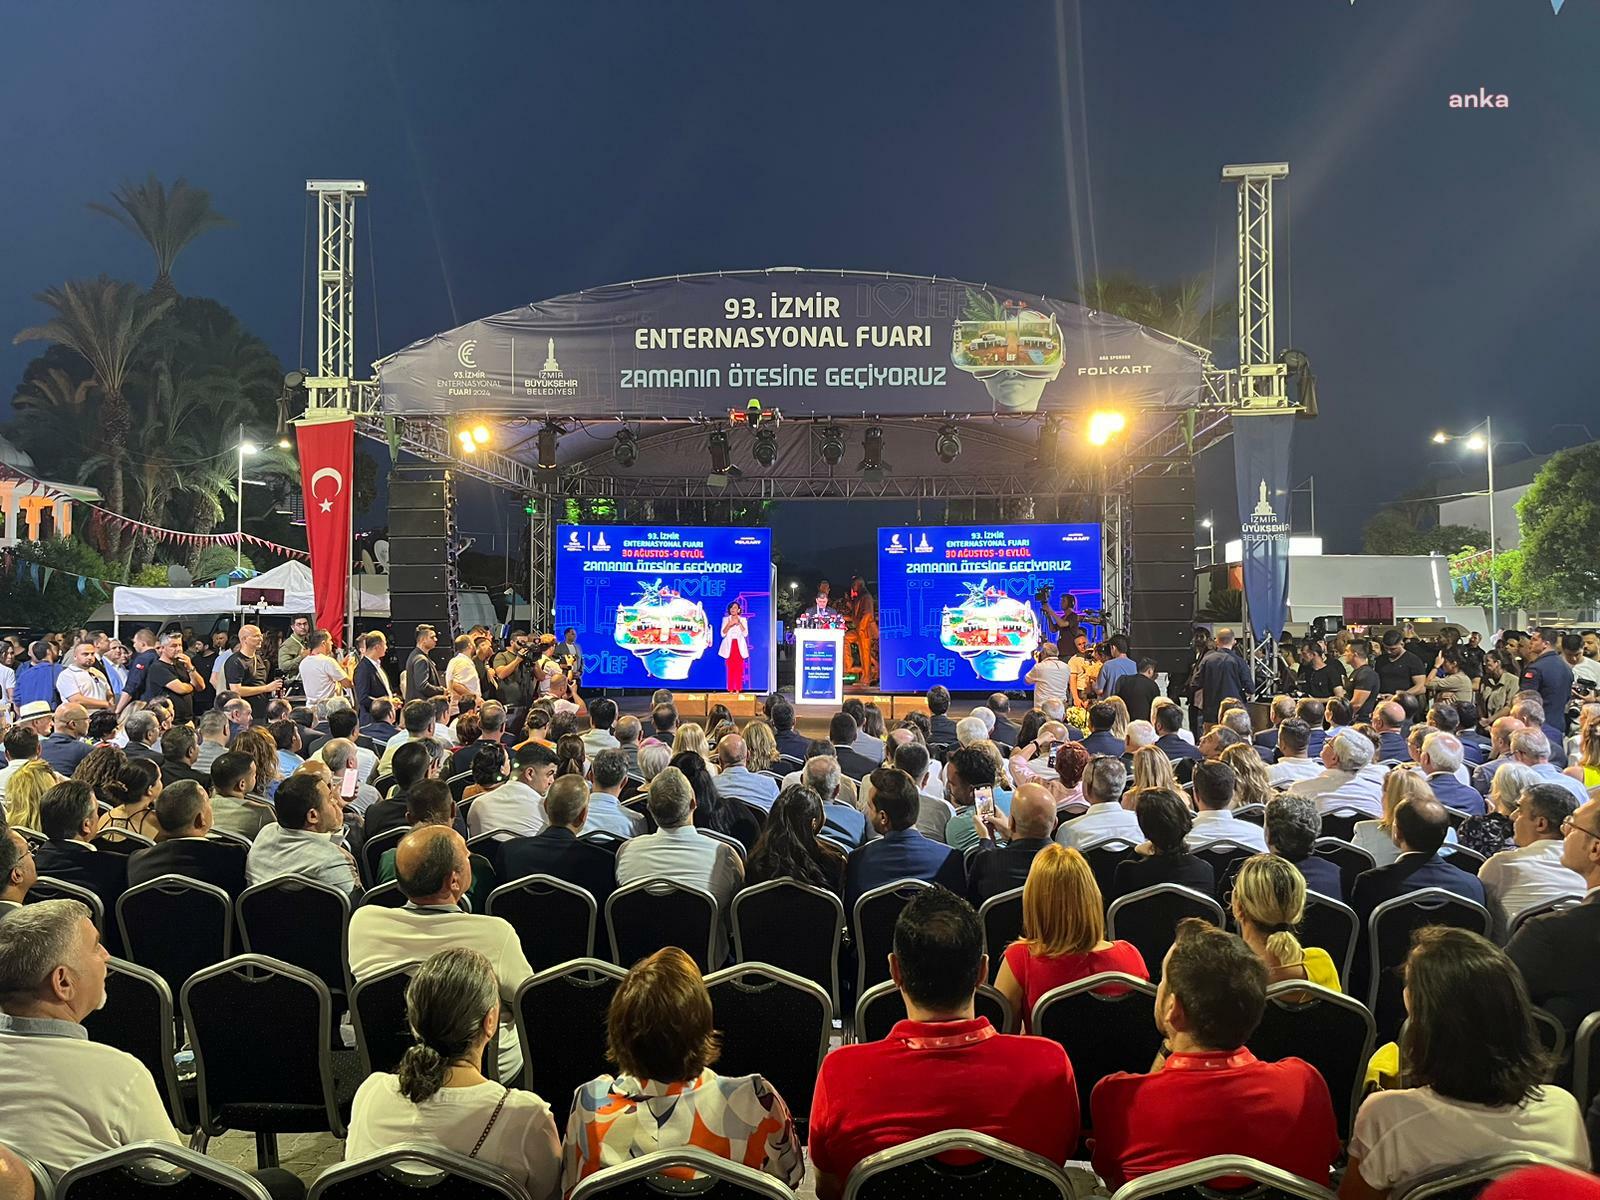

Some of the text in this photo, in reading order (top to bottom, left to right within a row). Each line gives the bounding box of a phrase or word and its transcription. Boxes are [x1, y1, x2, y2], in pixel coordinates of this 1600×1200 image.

[724, 291, 840, 319] 93. İZMİR
[635, 325, 931, 349] ENTERNASYONAL FUARI
[1078, 365, 1152, 376] FOLKART
[620, 363, 947, 389] ZAMANIN ÖTESİNE GEÇİYORUZ
[437, 380, 502, 388] ENTERNASYONAL
[448, 388, 472, 396] FUARI
[526, 388, 576, 396] BELEDİYESİ
[1241, 522, 1290, 532] ÜYÜKŞEHİR
[623, 540, 704, 548] ENTERNASYONAL FUARI
[946, 540, 1007, 548] ENTERNASYONAL
[622, 549, 633, 557] 30
[634, 548, 669, 558] AĞUSTOS
[680, 549, 705, 558] EYLÜL
[945, 550, 957, 558] 30
[957, 548, 994, 558] AĞUSTOS
[1005, 548, 1031, 557] EYLÜL
[583, 559, 743, 574] ZAMANIN ÖTESİNE GEÇİYORUZ
[906, 559, 1072, 573] ZAMANIN ÖTESİNE GEÇİYORUZ
